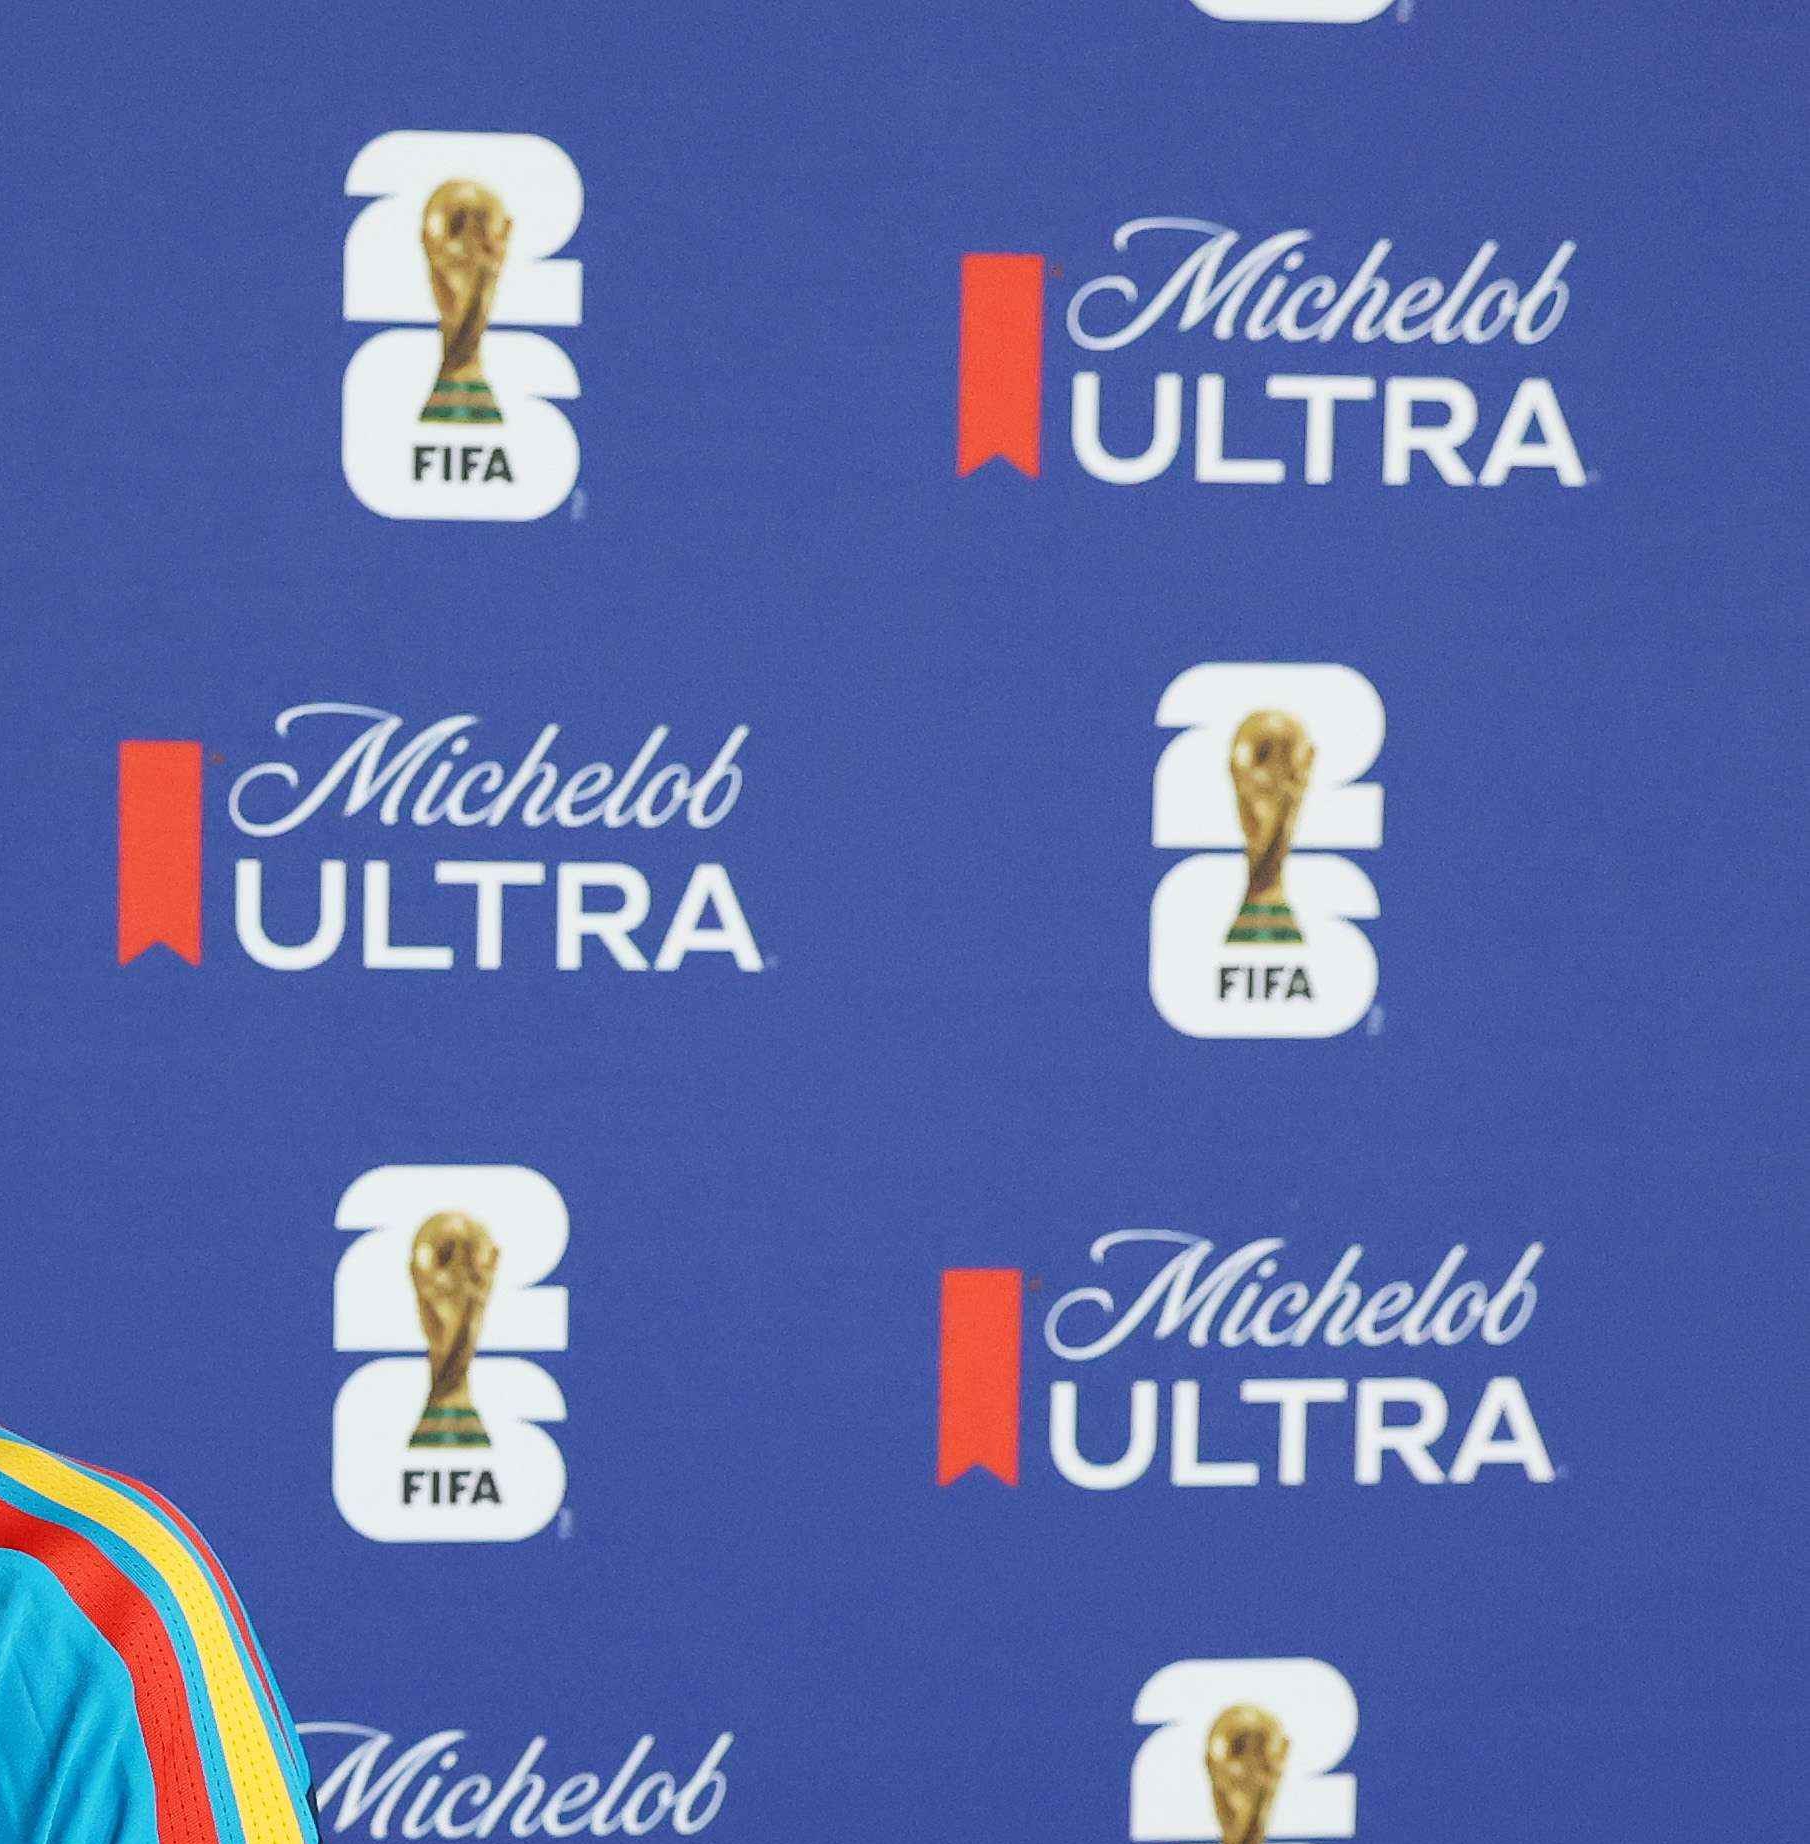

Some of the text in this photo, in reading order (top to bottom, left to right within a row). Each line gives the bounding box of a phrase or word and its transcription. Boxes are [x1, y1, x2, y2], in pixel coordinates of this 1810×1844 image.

[1067, 218, 1576, 351] Michelob
[414, 446, 513, 482] FIFA
[1071, 371, 1587, 487] ULTRA
[228, 703, 749, 837] Michelob
[235, 858, 764, 972] ULTRA
[1218, 966, 1312, 1000] FIFA
[1045, 1230, 1544, 1361] Michelob
[401, 1470, 501, 1505] FIFA
[1049, 1376, 1556, 1490] ULTRA
[294, 1721, 734, 1839] Michelob
